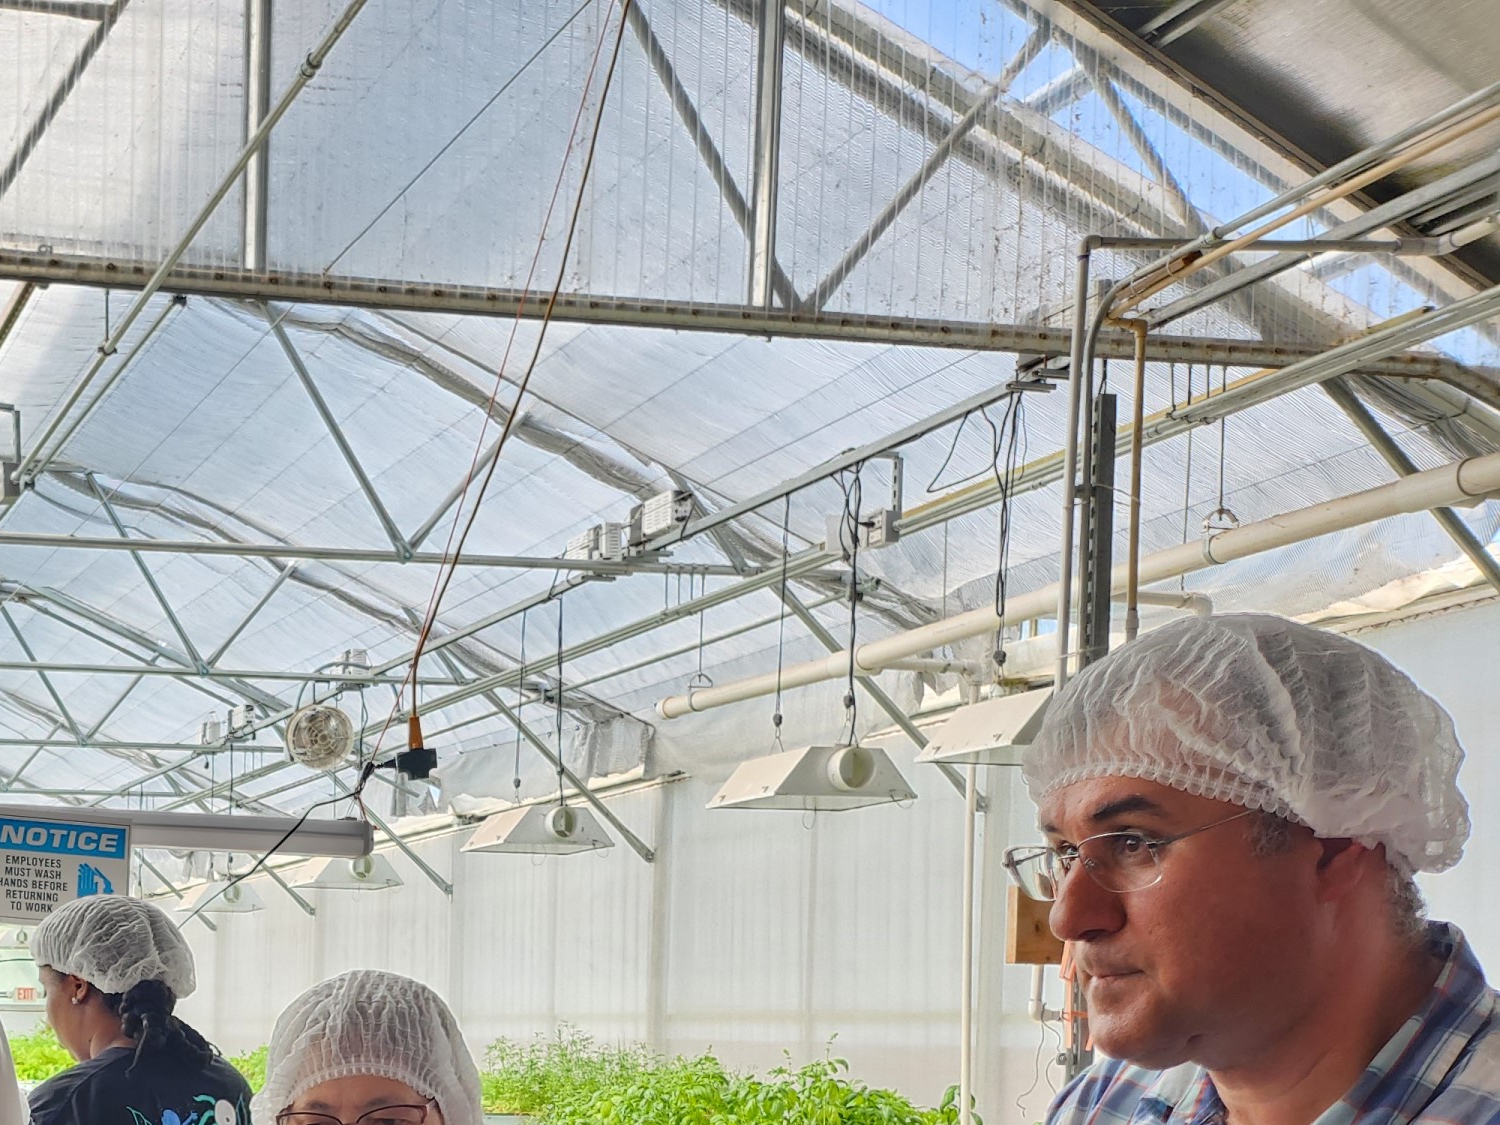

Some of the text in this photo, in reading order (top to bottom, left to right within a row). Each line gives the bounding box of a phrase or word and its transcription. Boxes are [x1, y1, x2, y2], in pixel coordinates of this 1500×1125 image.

[0, 825, 119, 852] NOTICE
[6, 855, 62, 868] EMPLOYEES
[5, 867, 61, 879] MUST WASH
[32, 880, 68, 891] BEFORE
[6, 890, 58, 902] RETURNING
[10, 902, 53, 913] TO WORK
